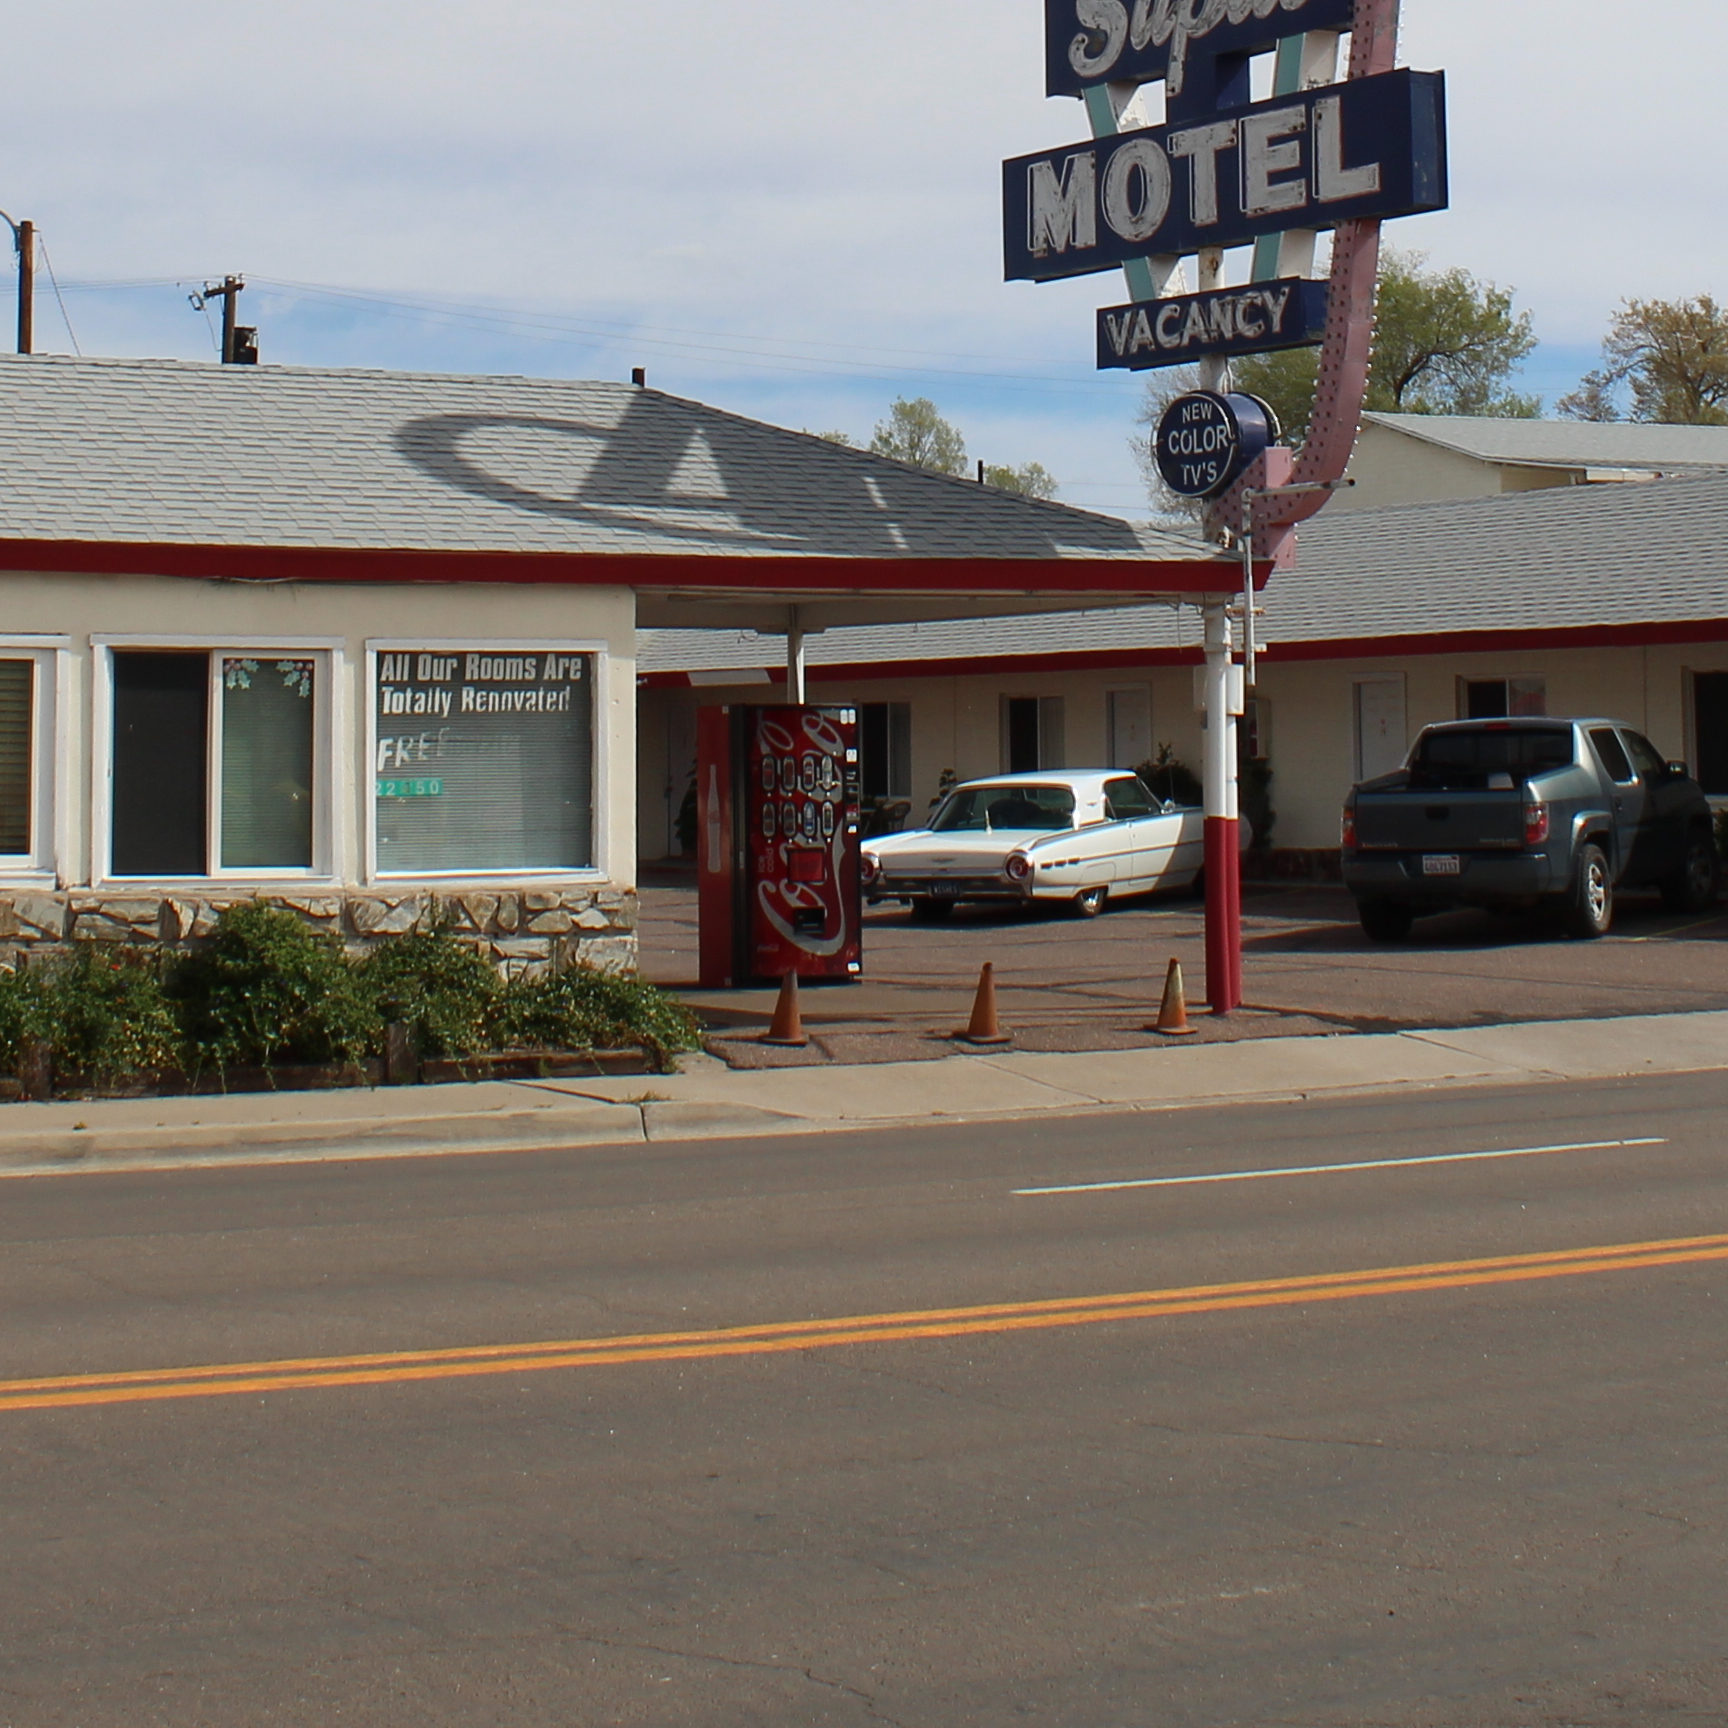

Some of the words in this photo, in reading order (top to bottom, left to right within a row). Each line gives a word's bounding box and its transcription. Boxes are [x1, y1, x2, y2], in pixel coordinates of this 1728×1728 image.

[1026, 96, 1381, 258] MOTEL
[1104, 285, 1291, 357] VACANCY
[1181, 402, 1213, 424] NEW
[1167, 424, 1229, 455] COLOR
[1180, 460, 1218, 486] TV'S
[380, 653, 410, 682] All
[416, 653, 458, 682] Our
[464, 653, 537, 681] Rooms
[543, 653, 583, 681] Are
[381, 685, 453, 718] Totally
[375, 780, 440, 796] 2250
